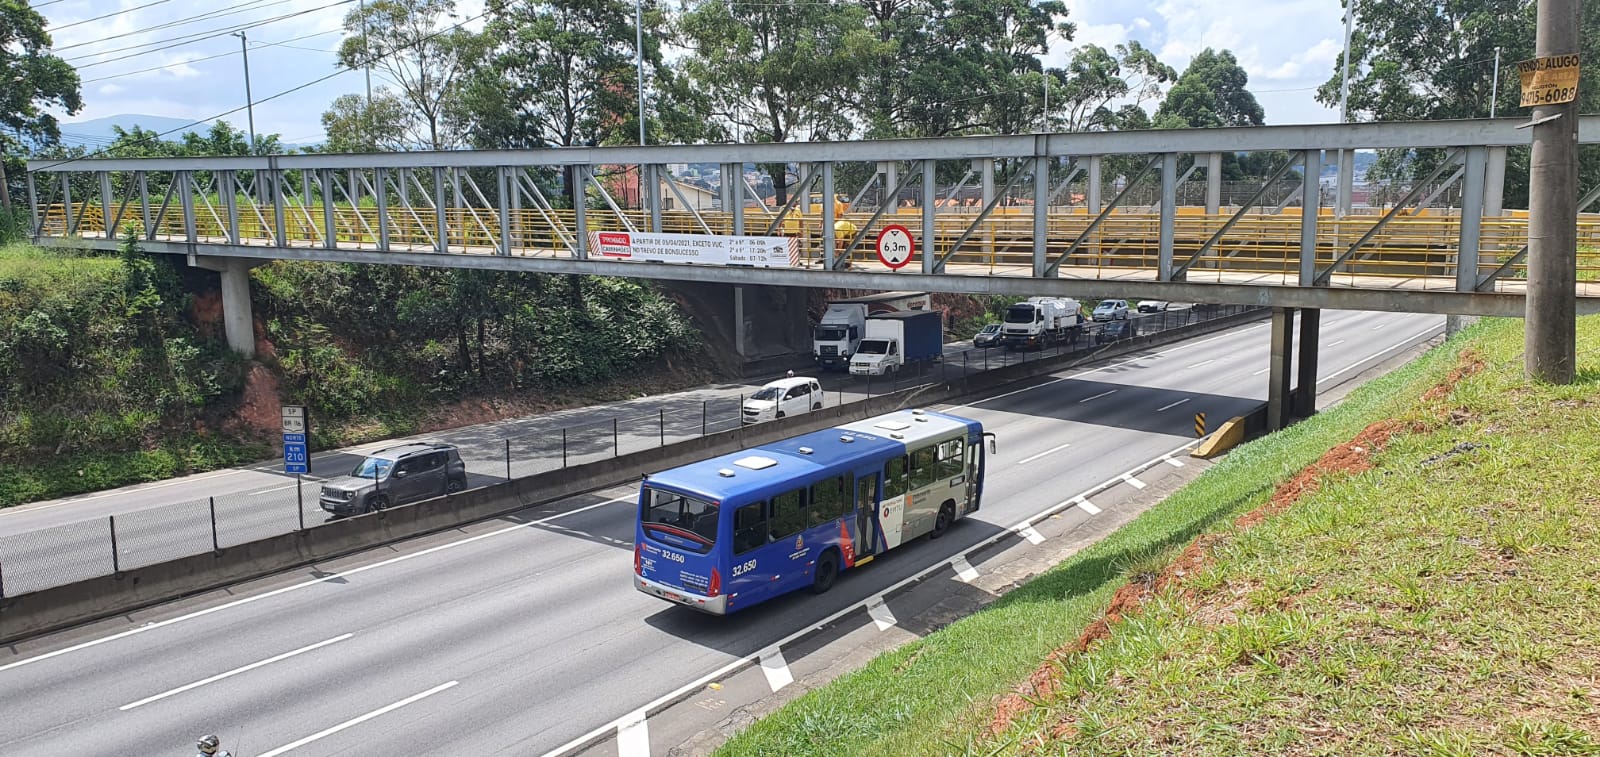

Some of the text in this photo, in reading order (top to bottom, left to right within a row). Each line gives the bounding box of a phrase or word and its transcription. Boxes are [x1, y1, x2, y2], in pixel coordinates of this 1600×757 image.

[1518, 59, 1539, 72] VENDO
[1545, 55, 1579, 69] ALUGO
[884, 242, 907, 252] 6,3m
[287, 453, 304, 461] 210
[662, 549, 685, 564] 32.650
[732, 559, 757, 577] 32.650
